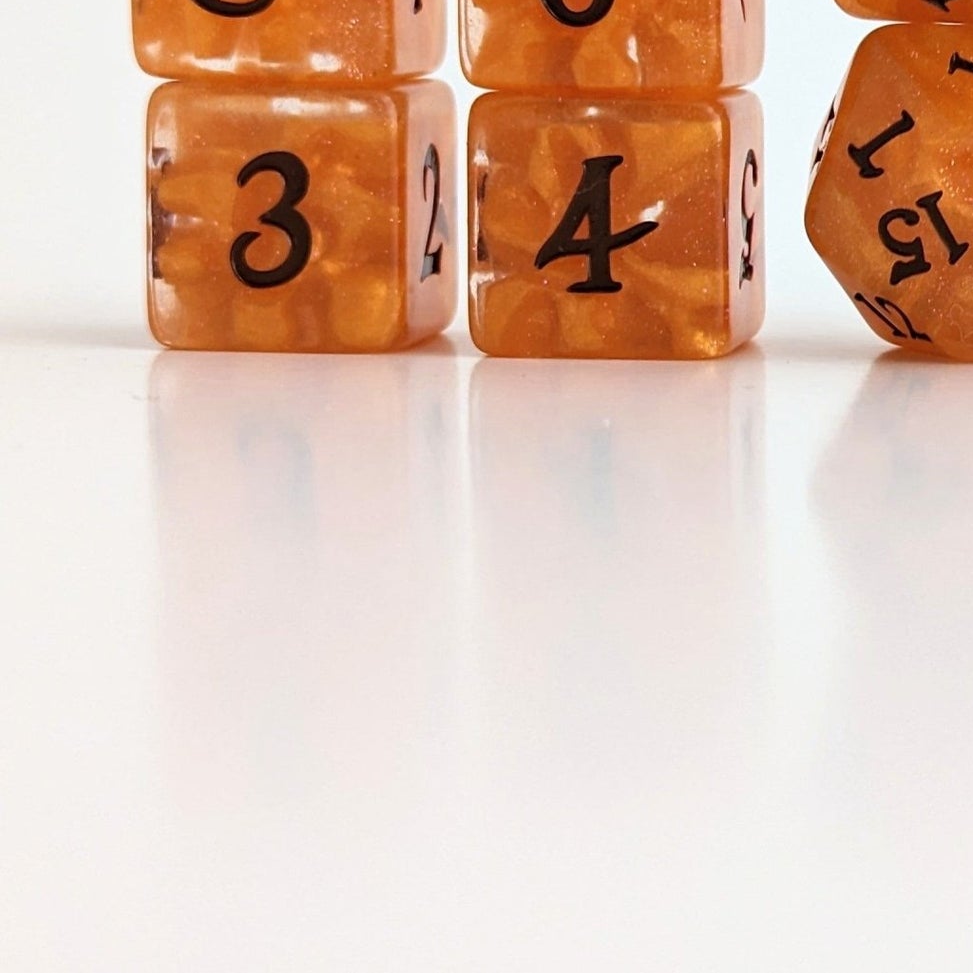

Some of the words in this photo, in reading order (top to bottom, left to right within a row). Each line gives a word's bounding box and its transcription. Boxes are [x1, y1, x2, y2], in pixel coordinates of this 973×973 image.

[230, 151, 312, 289] 3
[420, 143, 442, 282] 2
[534, 155, 659, 294] 4
[878, 190, 969, 286] 15
